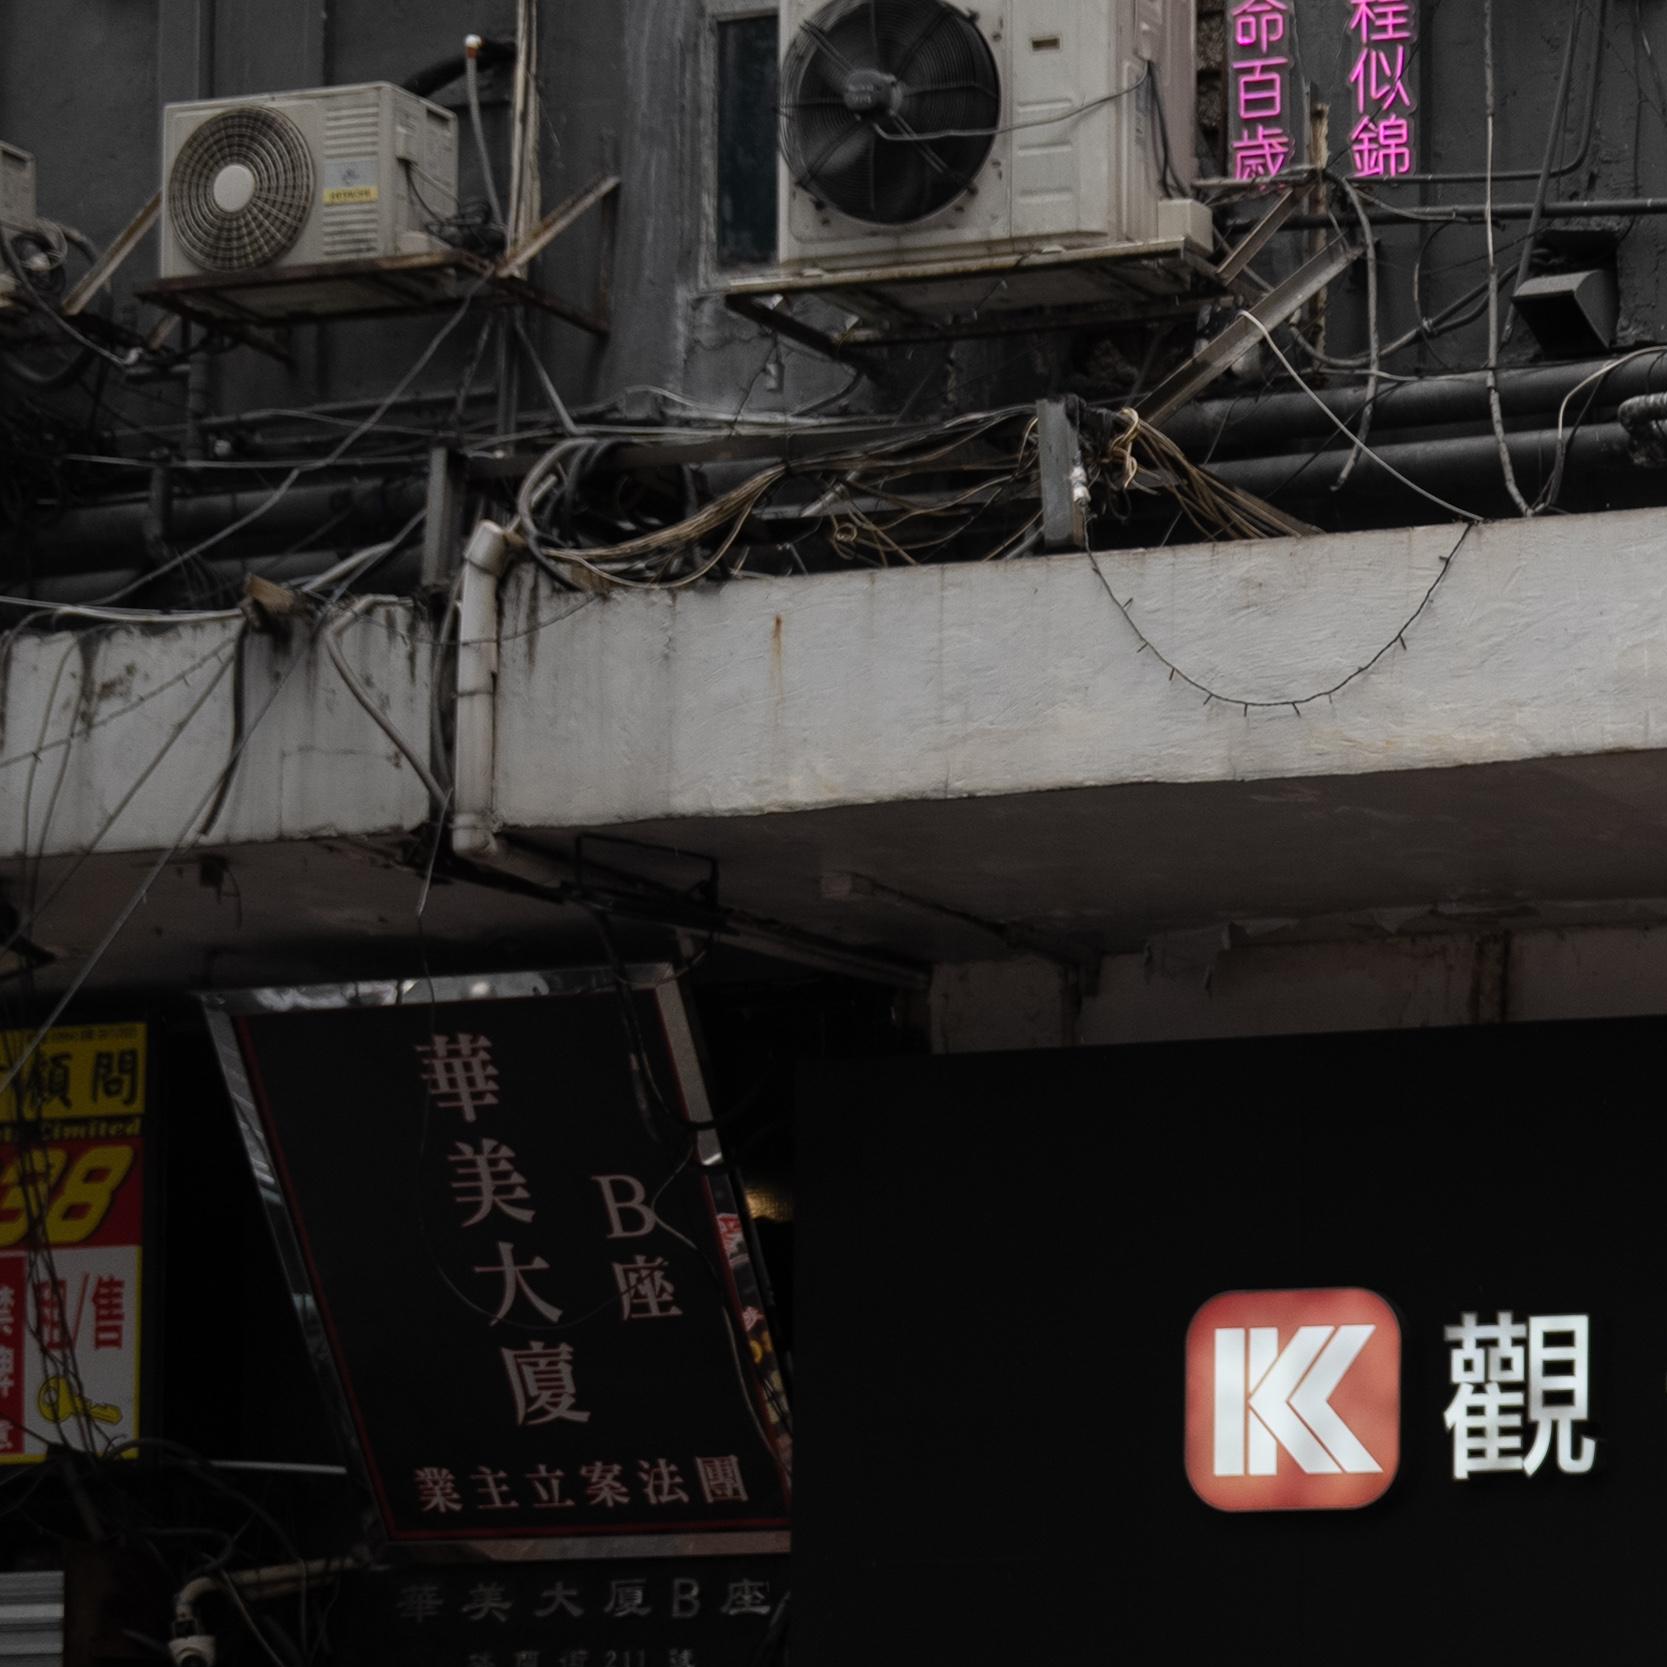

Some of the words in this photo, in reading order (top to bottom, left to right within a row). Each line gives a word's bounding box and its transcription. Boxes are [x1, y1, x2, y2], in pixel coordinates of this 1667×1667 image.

[413, 1455, 749, 1516] 業主立案法團
